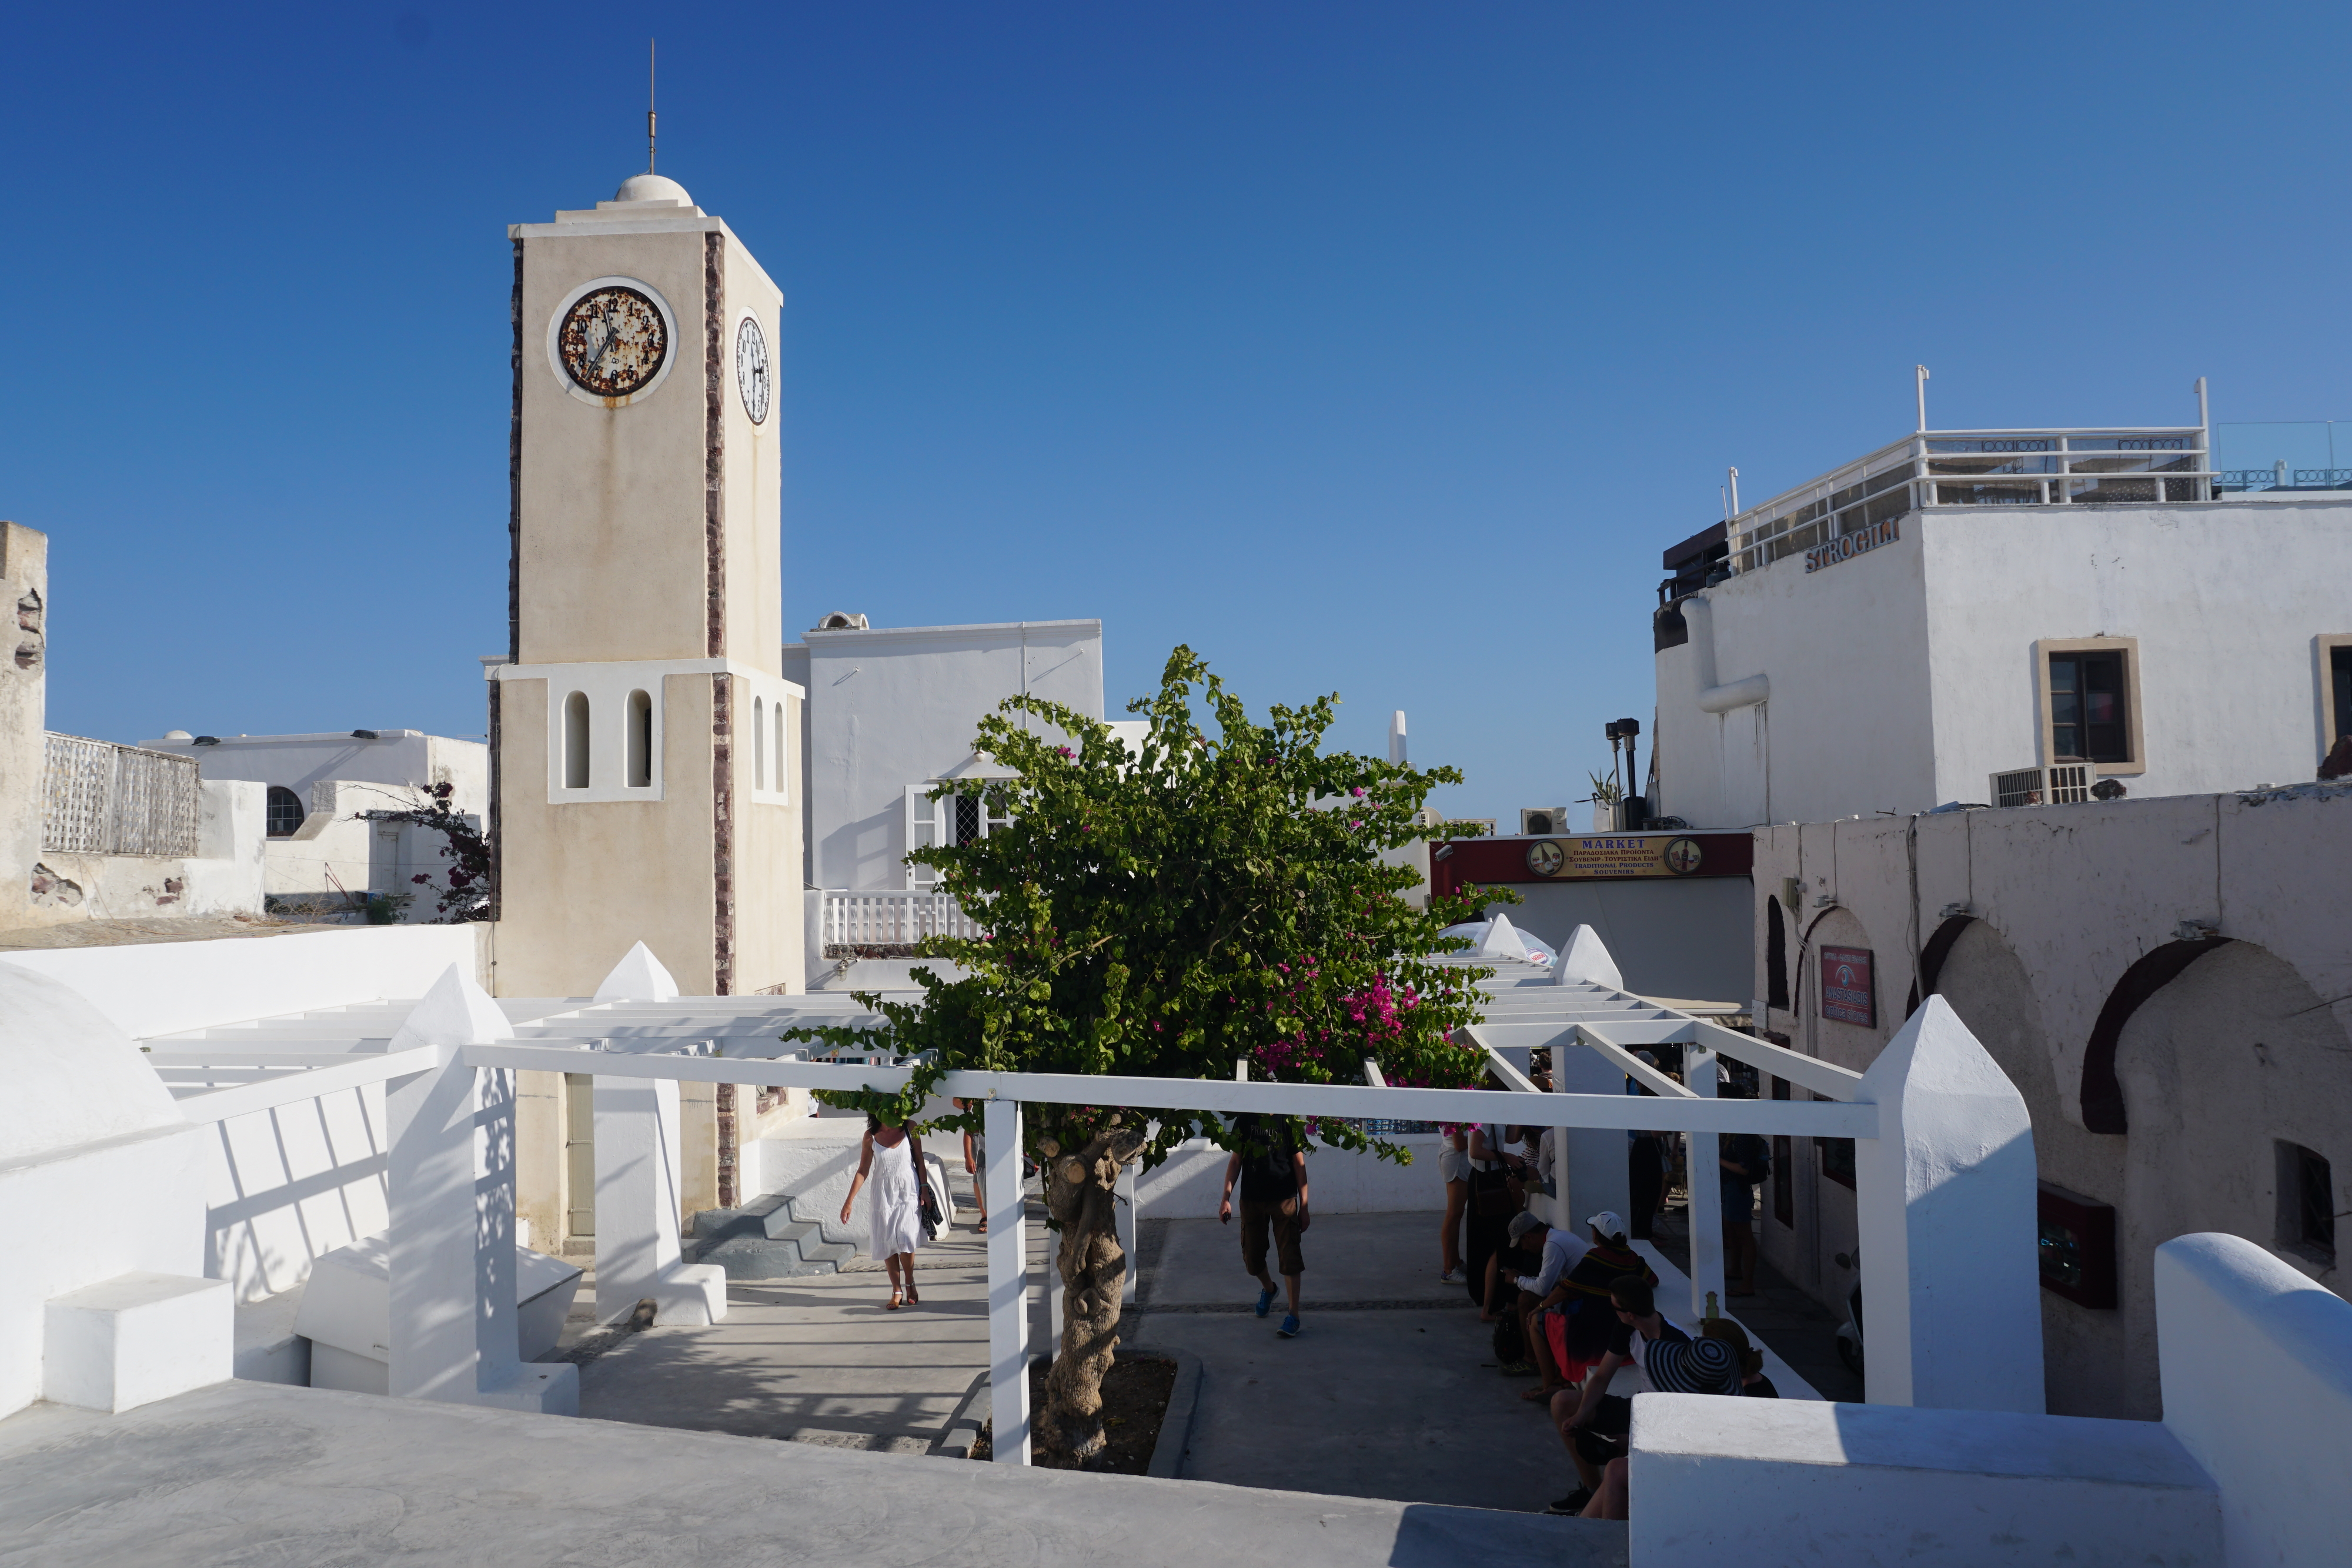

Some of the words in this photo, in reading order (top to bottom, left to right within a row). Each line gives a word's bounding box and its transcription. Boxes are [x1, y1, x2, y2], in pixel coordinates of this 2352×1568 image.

[590, 303, 599, 318] 11
[608, 297, 618, 312] 12
[629, 302, 634, 316] 1
[577, 319, 587, 334] 10
[643, 315, 649, 330] 2
[647, 332, 654, 347] 3
[746, 329, 750, 344] 11
[751, 330, 756, 345] 12
[742, 339, 746, 353] 10
[579, 353, 585, 367] 8
[642, 350, 650, 365] 4
[740, 353, 743, 367] 9
[610, 369, 617, 383] 6
[628, 365, 634, 380] 5
[742, 372, 745, 386] 8
[763, 376, 766, 389] 3
[747, 389, 750, 404] 7
[757, 399, 760, 413] 5
[1805, 517, 1900, 574] STROGILI
[1582, 840, 1645, 849] MARKET
[1825, 985, 1868, 1007] ANASTASIADIS
[1825, 1004, 1846, 1019] optica
[1847, 1008, 1868, 1025] stores
